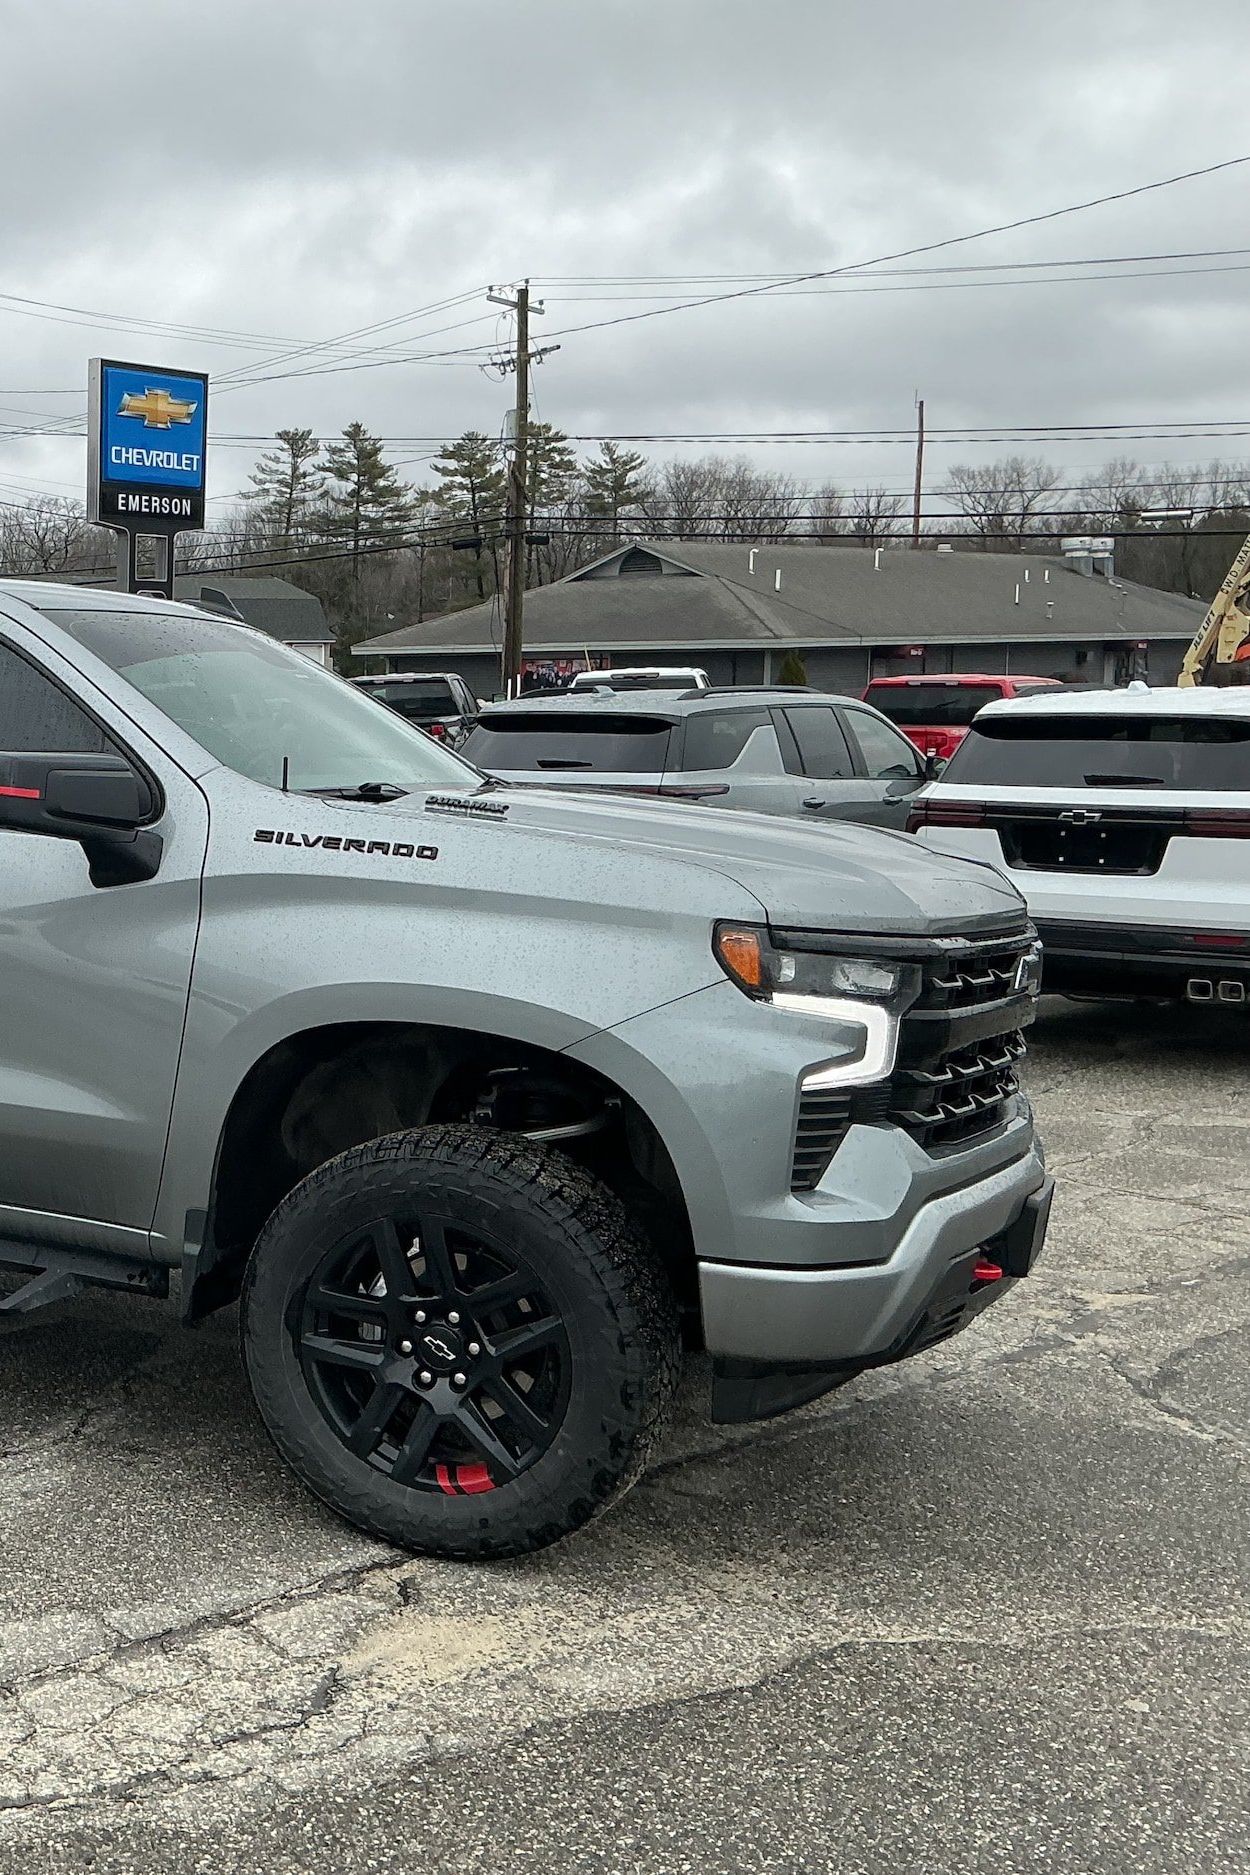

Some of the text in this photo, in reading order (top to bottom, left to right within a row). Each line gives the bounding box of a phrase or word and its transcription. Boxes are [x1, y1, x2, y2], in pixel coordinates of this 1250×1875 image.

[111, 445, 200, 472] CHEVROLET
[117, 493, 191, 516] EMERSON
[1193, 610, 1215, 651] JLG LIFT
[425, 796, 510, 815] DURAMAX
[253, 829, 440, 861] SILVERADO
